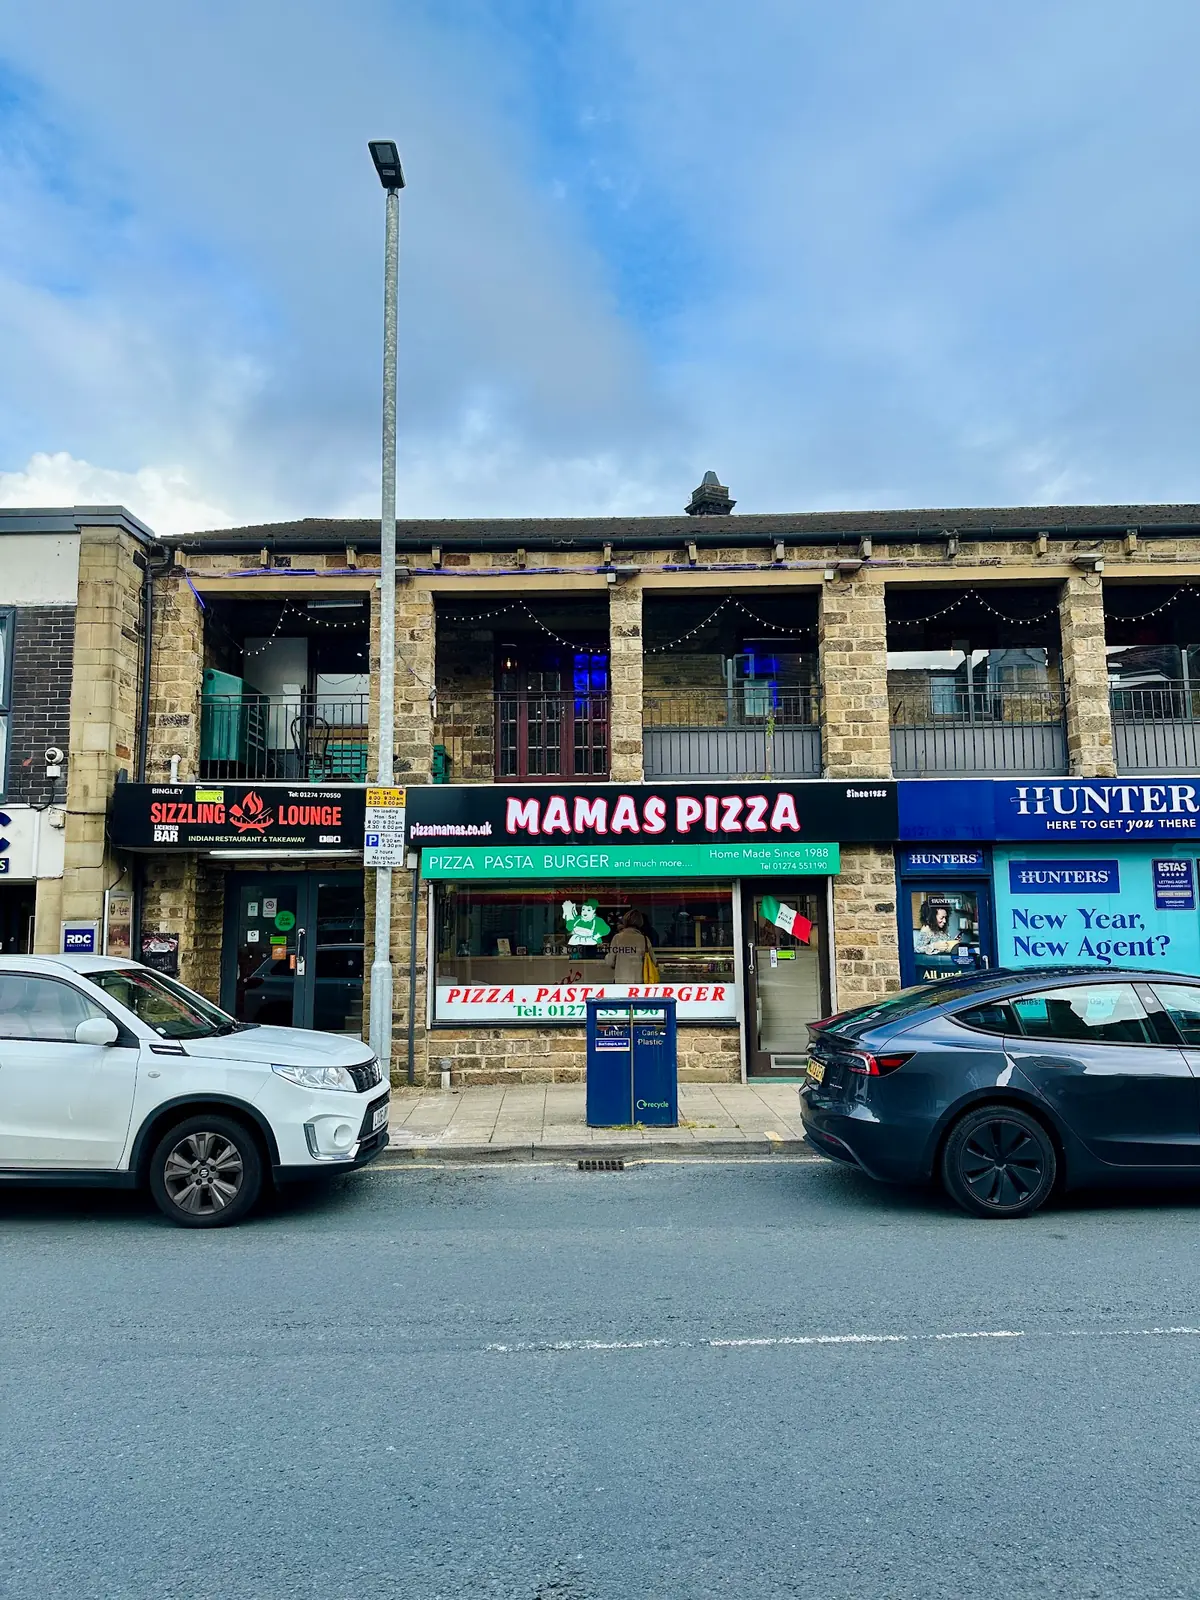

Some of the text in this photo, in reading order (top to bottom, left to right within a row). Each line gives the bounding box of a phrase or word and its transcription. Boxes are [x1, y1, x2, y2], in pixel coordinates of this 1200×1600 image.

[151, 802, 342, 825] SIZZLING LOUNGE
[505, 792, 801, 836] MAMAS PIZZA
[410, 821, 493, 839] pizzamamas.co.uk
[1047, 819, 1196, 832] HERE TO GET you THERE
[154, 831, 178, 842] BAR
[369, 836, 378, 846] P
[709, 848, 829, 859] Home Made Since 1988
[909, 854, 977, 864] HUNTERS
[429, 856, 475, 869] PIZZA
[484, 855, 534, 869] PASTA
[543, 854, 609, 868] BURGER
[614, 859, 631, 867] and
[633, 859, 657, 867] much
[1158, 862, 1187, 872] ESTAS
[1018, 870, 1109, 884] HUNTERS
[1012, 909, 1145, 931] New Year,
[66, 934, 92, 944] RDC
[1014, 935, 1170, 965] New Agent?
[923, 970, 937, 979] All
[446, 988, 516, 1003] PIZZA
[534, 988, 605, 1002] PASTA
[627, 986, 726, 1002] BURGER
[513, 1004, 543, 1016] Tel:
[548, 1004, 587, 1016] 0127
